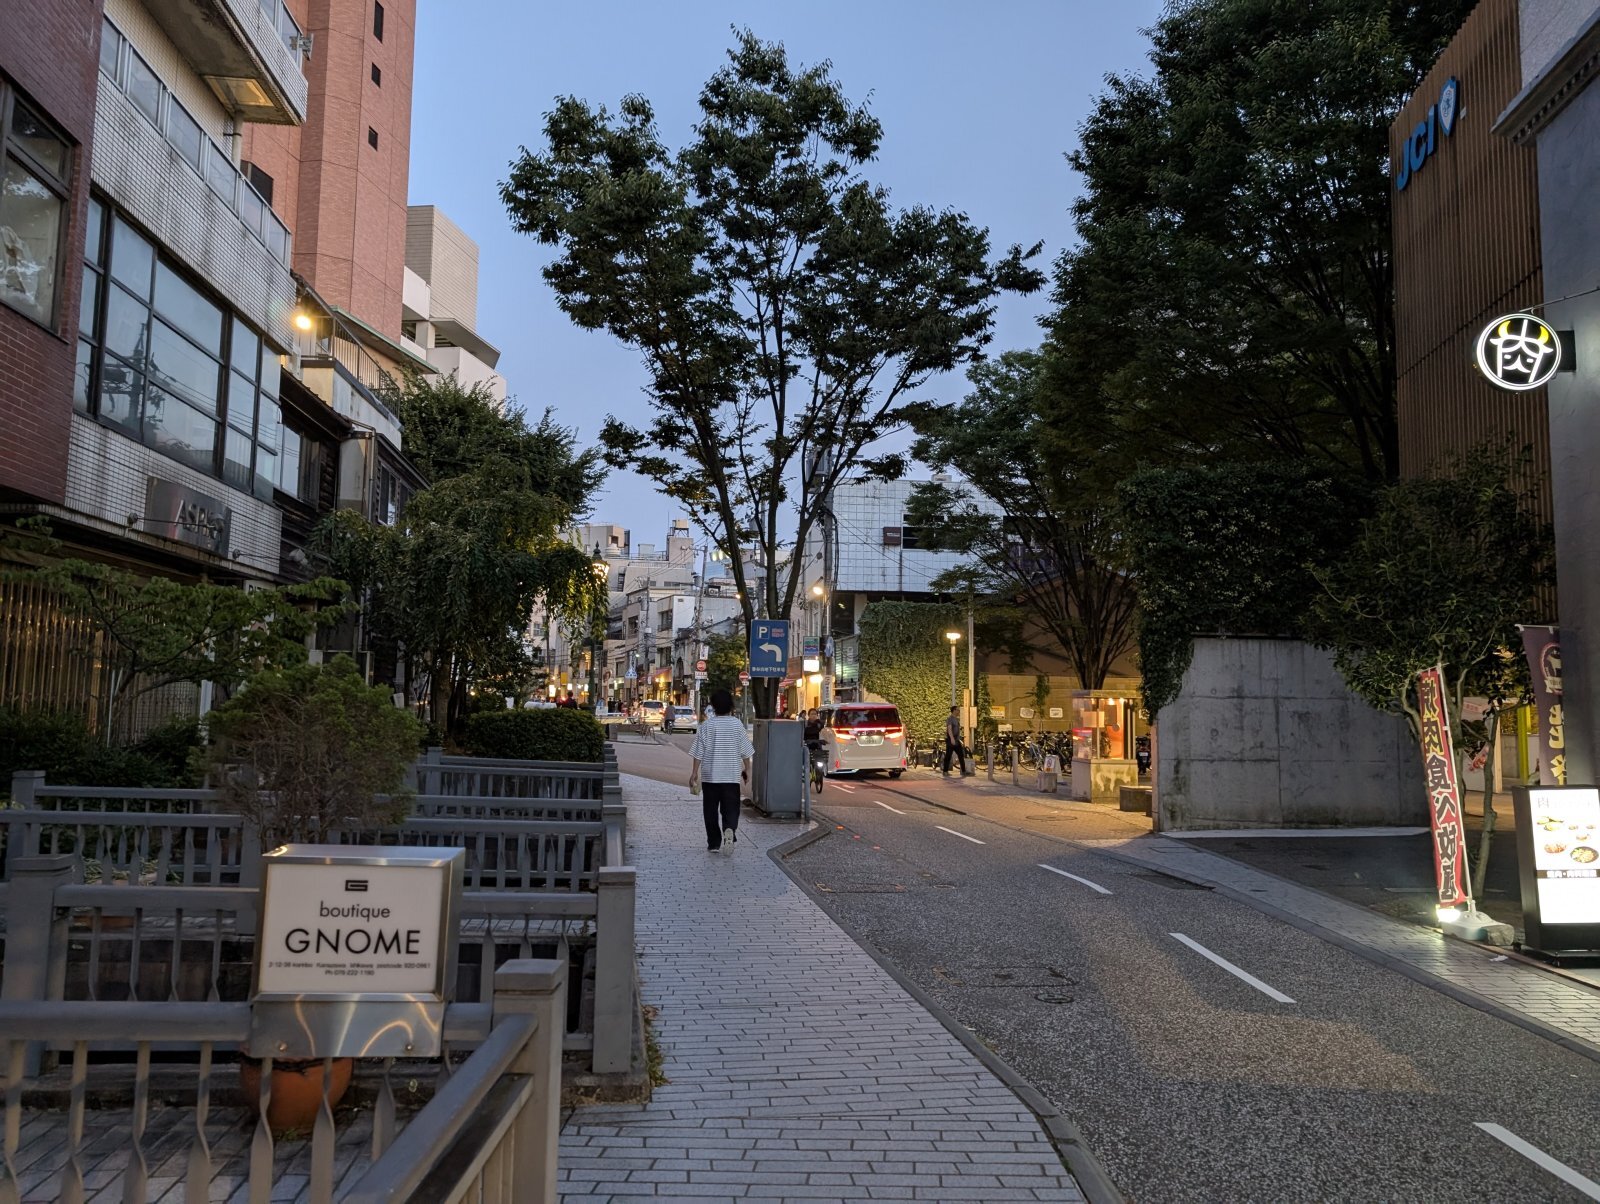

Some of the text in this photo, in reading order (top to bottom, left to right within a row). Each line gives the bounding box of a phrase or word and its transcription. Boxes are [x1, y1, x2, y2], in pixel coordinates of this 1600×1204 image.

[1396, 104, 1437, 191] JCI
[759, 626, 768, 639] P
[319, 900, 391, 922] boutique
[285, 928, 421, 955] GNOME
